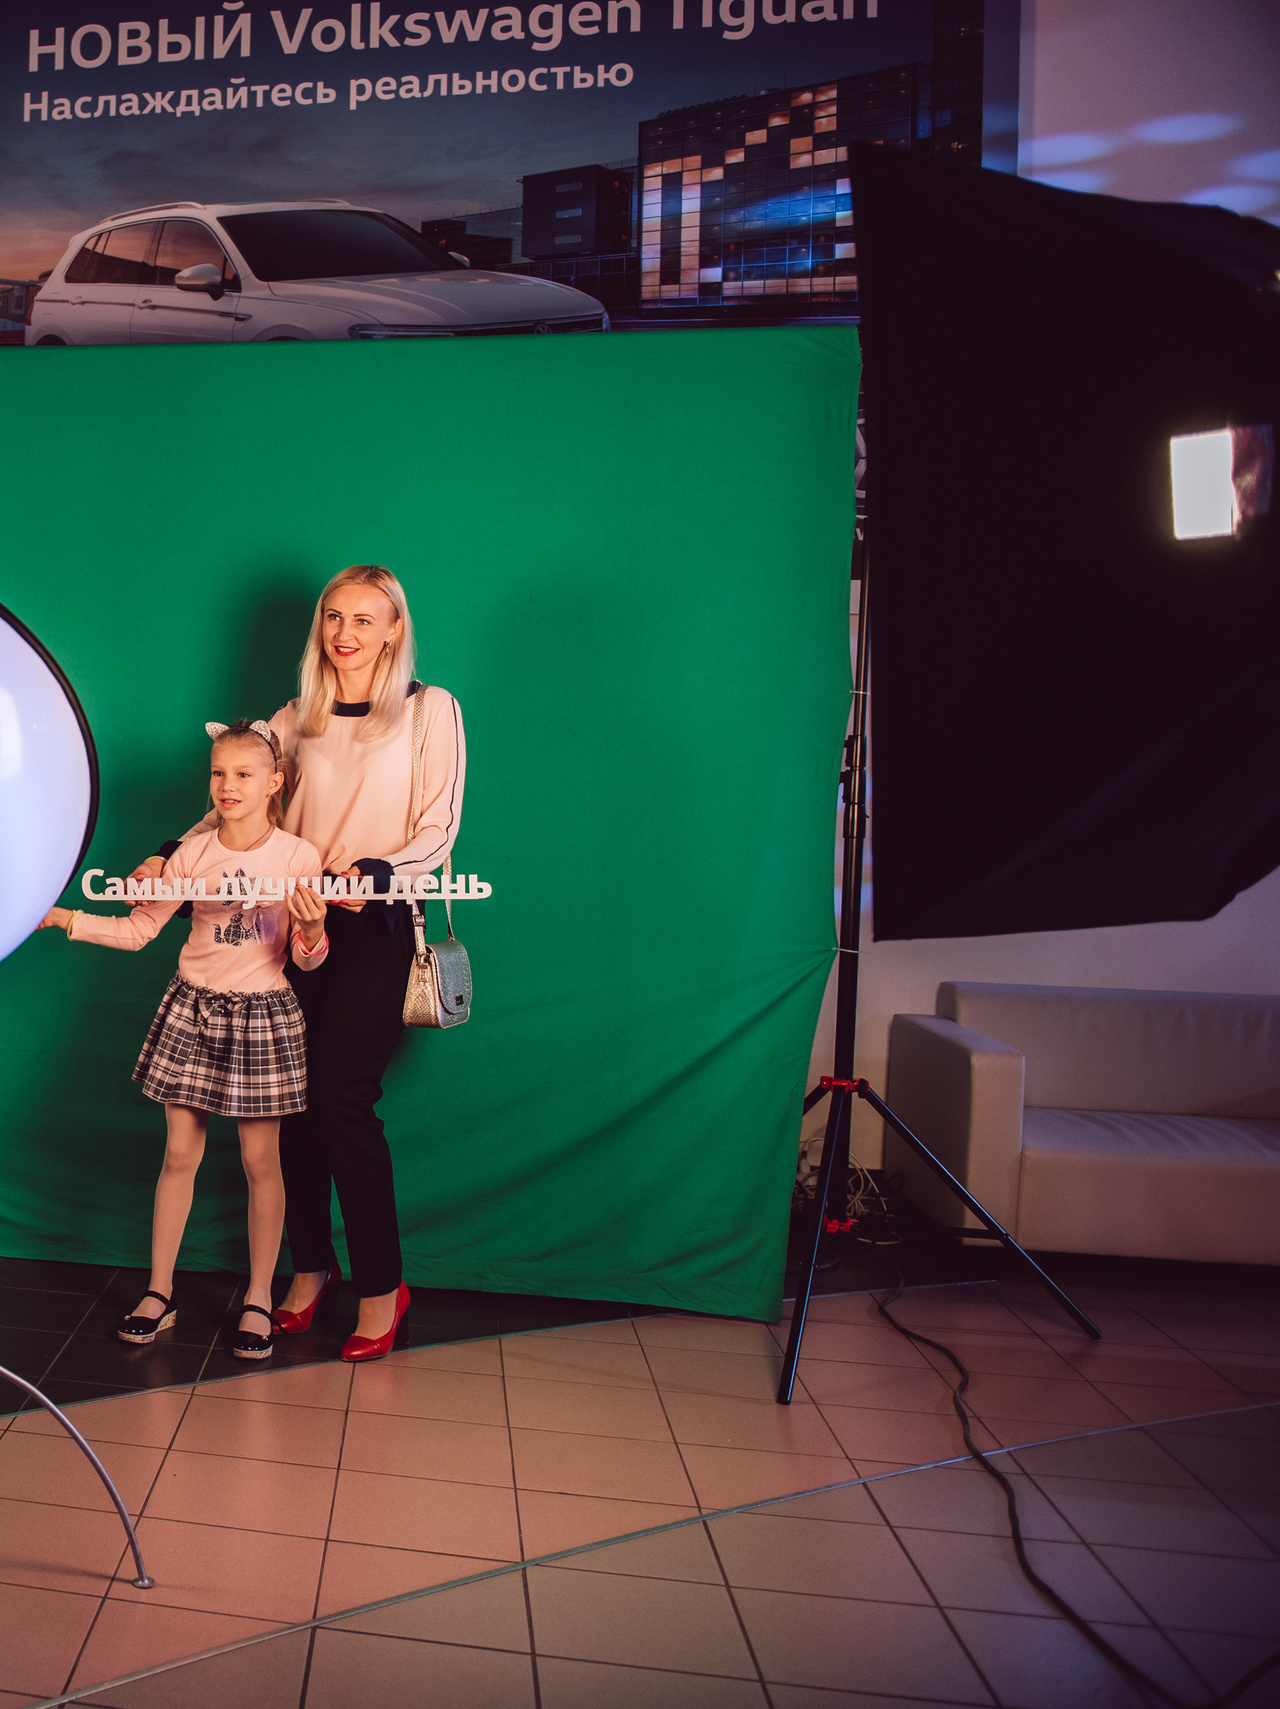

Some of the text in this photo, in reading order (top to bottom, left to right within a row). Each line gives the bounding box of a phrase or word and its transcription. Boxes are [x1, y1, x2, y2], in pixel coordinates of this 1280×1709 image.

[28, 0, 251, 72] НОВЫЙ
[270, 0, 641, 55] Volkswagen
[23, 63, 634, 122] Наслаждайтесь реальностью
[385, 874, 493, 905] день
